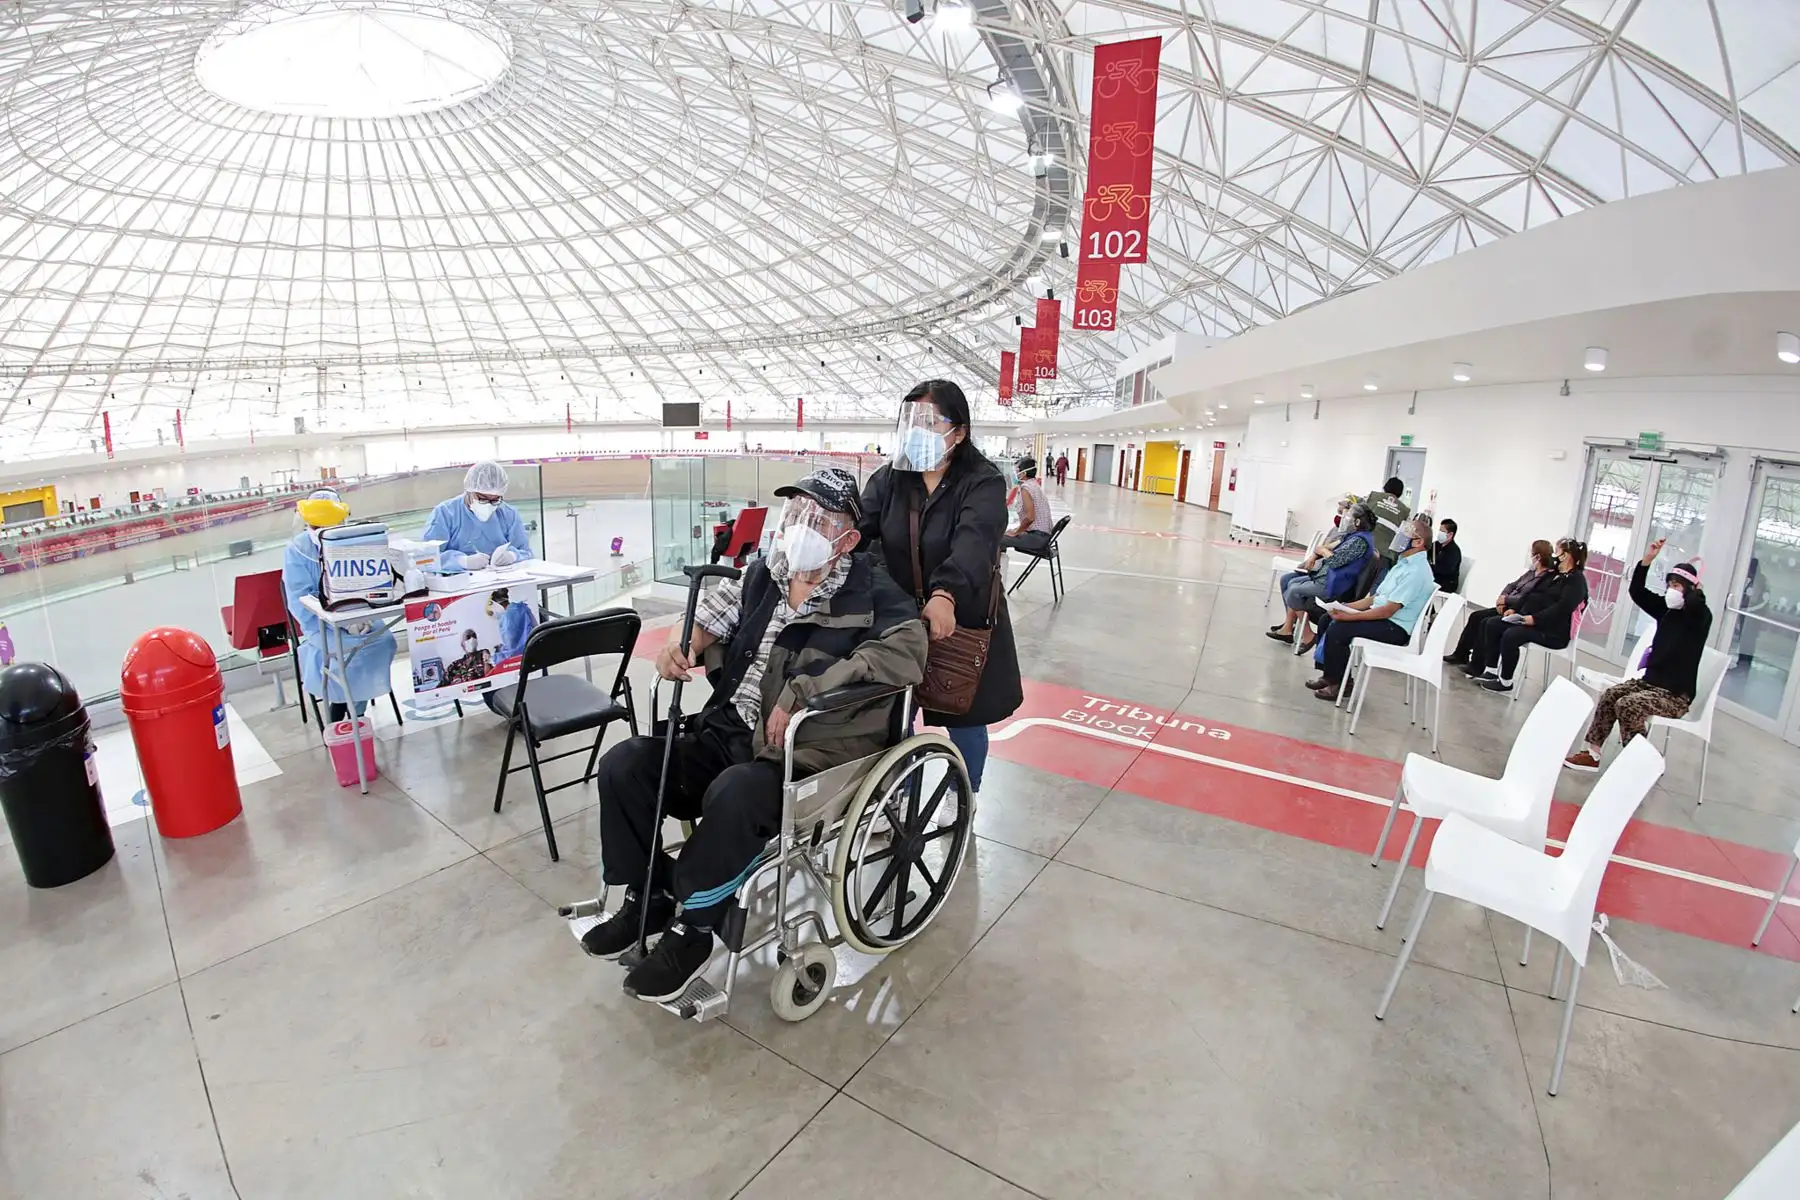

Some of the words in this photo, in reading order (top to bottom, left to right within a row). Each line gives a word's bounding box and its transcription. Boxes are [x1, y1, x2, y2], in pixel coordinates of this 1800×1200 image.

[1088, 230, 1141, 259] 102
[1077, 308, 1113, 328] 103
[1034, 365, 1056, 378] 104
[1018, 382, 1036, 393] 105
[326, 558, 391, 577] MINSA
[1060, 709, 1157, 740] Block
[1082, 695, 1232, 741] Tribuna
